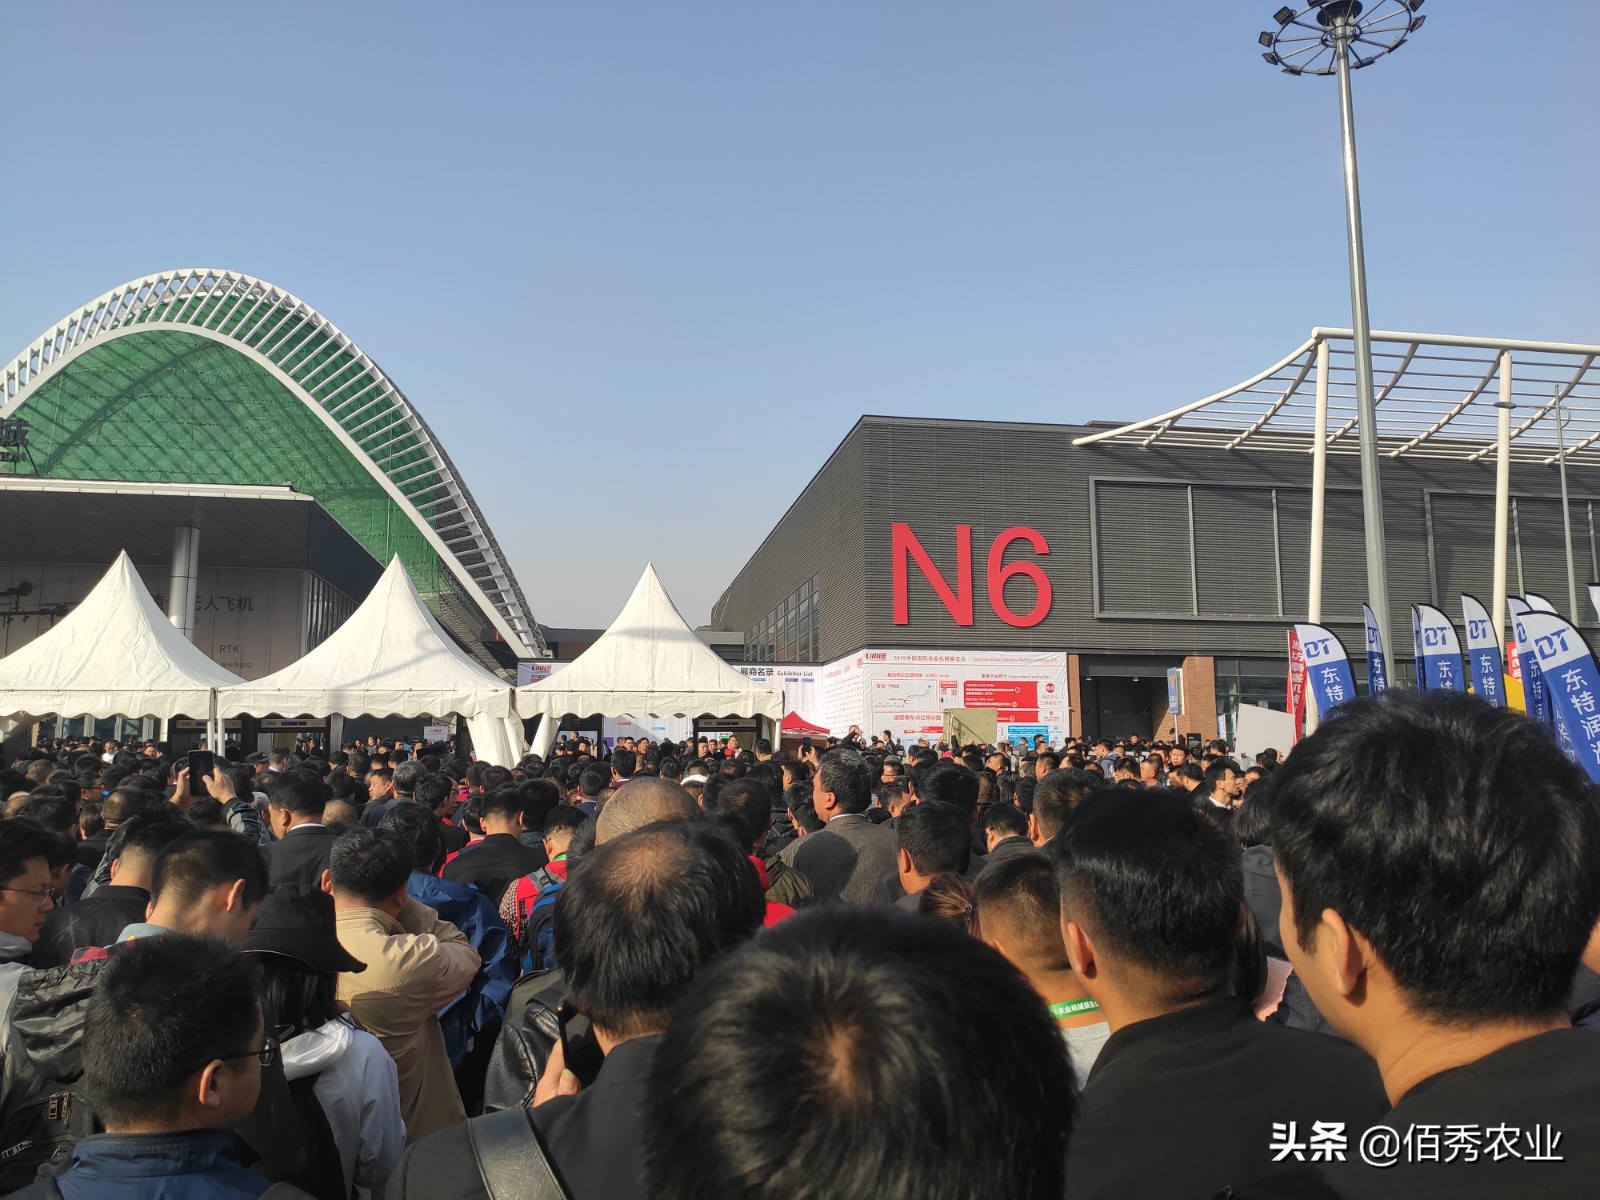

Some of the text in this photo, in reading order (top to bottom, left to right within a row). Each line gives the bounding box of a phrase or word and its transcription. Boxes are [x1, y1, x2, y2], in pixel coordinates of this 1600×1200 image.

[892, 522, 1053, 628] N6
[219, 644, 240, 654] RTK
[1304, 637, 1330, 659] DT
[1424, 626, 1448, 647] DT
[1533, 627, 1568, 662] DT
[1479, 654, 1498, 708] 东特
